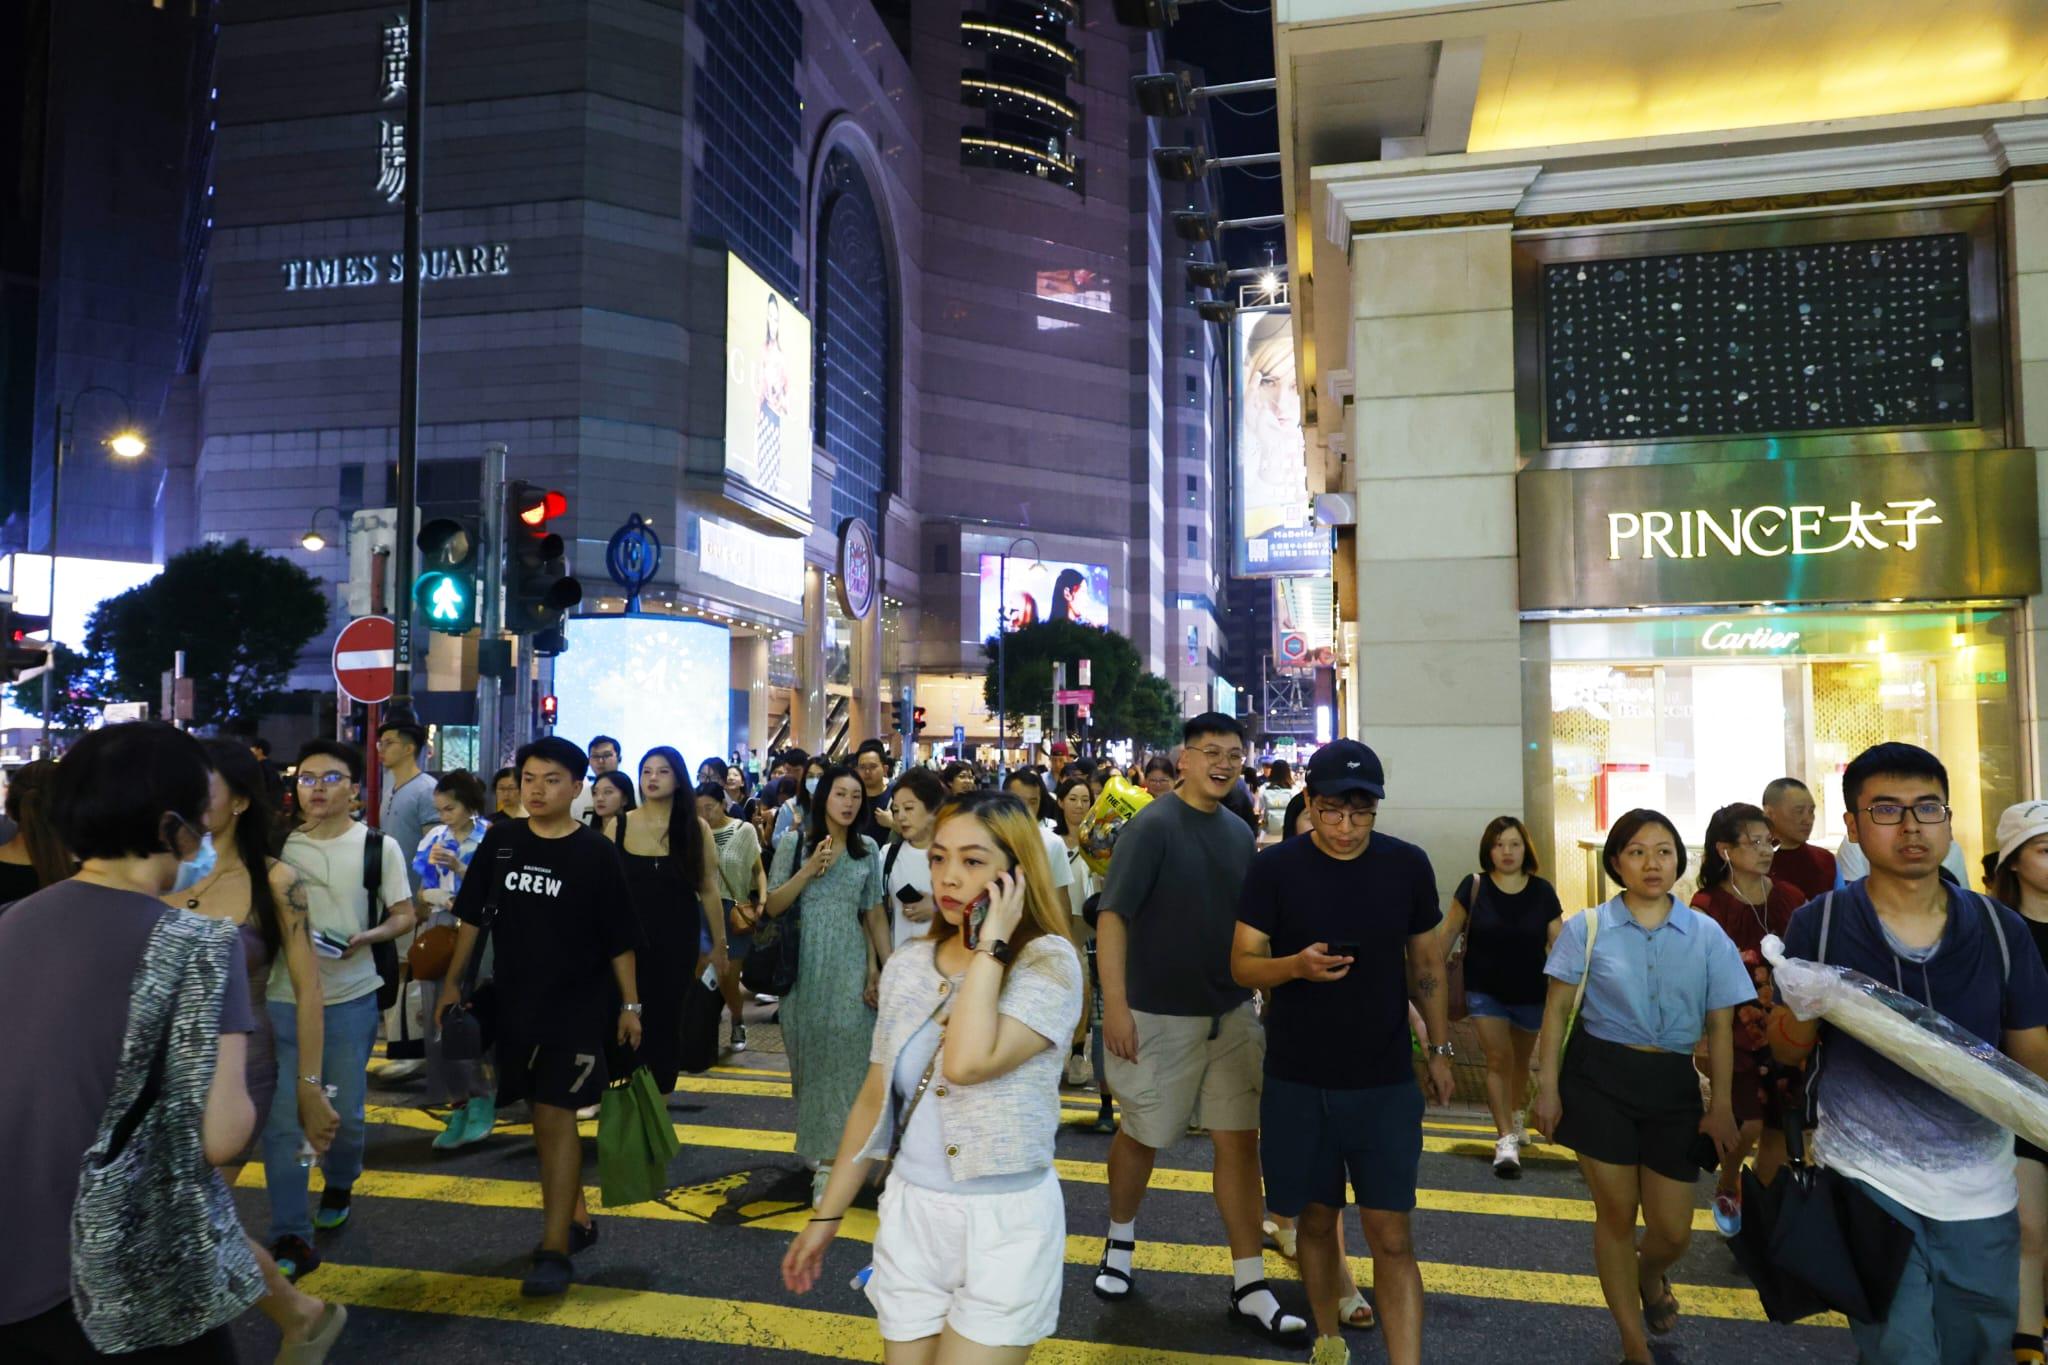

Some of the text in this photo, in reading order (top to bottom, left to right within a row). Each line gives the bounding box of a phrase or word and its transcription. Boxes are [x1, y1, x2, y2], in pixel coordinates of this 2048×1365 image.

[282, 244, 508, 291] TIMES SUARE
[1608, 505, 1827, 560] PRINCE
[1702, 621, 1800, 651] Cartier
[504, 871, 562, 898] CREW
[569, 1053, 596, 1093] 7
